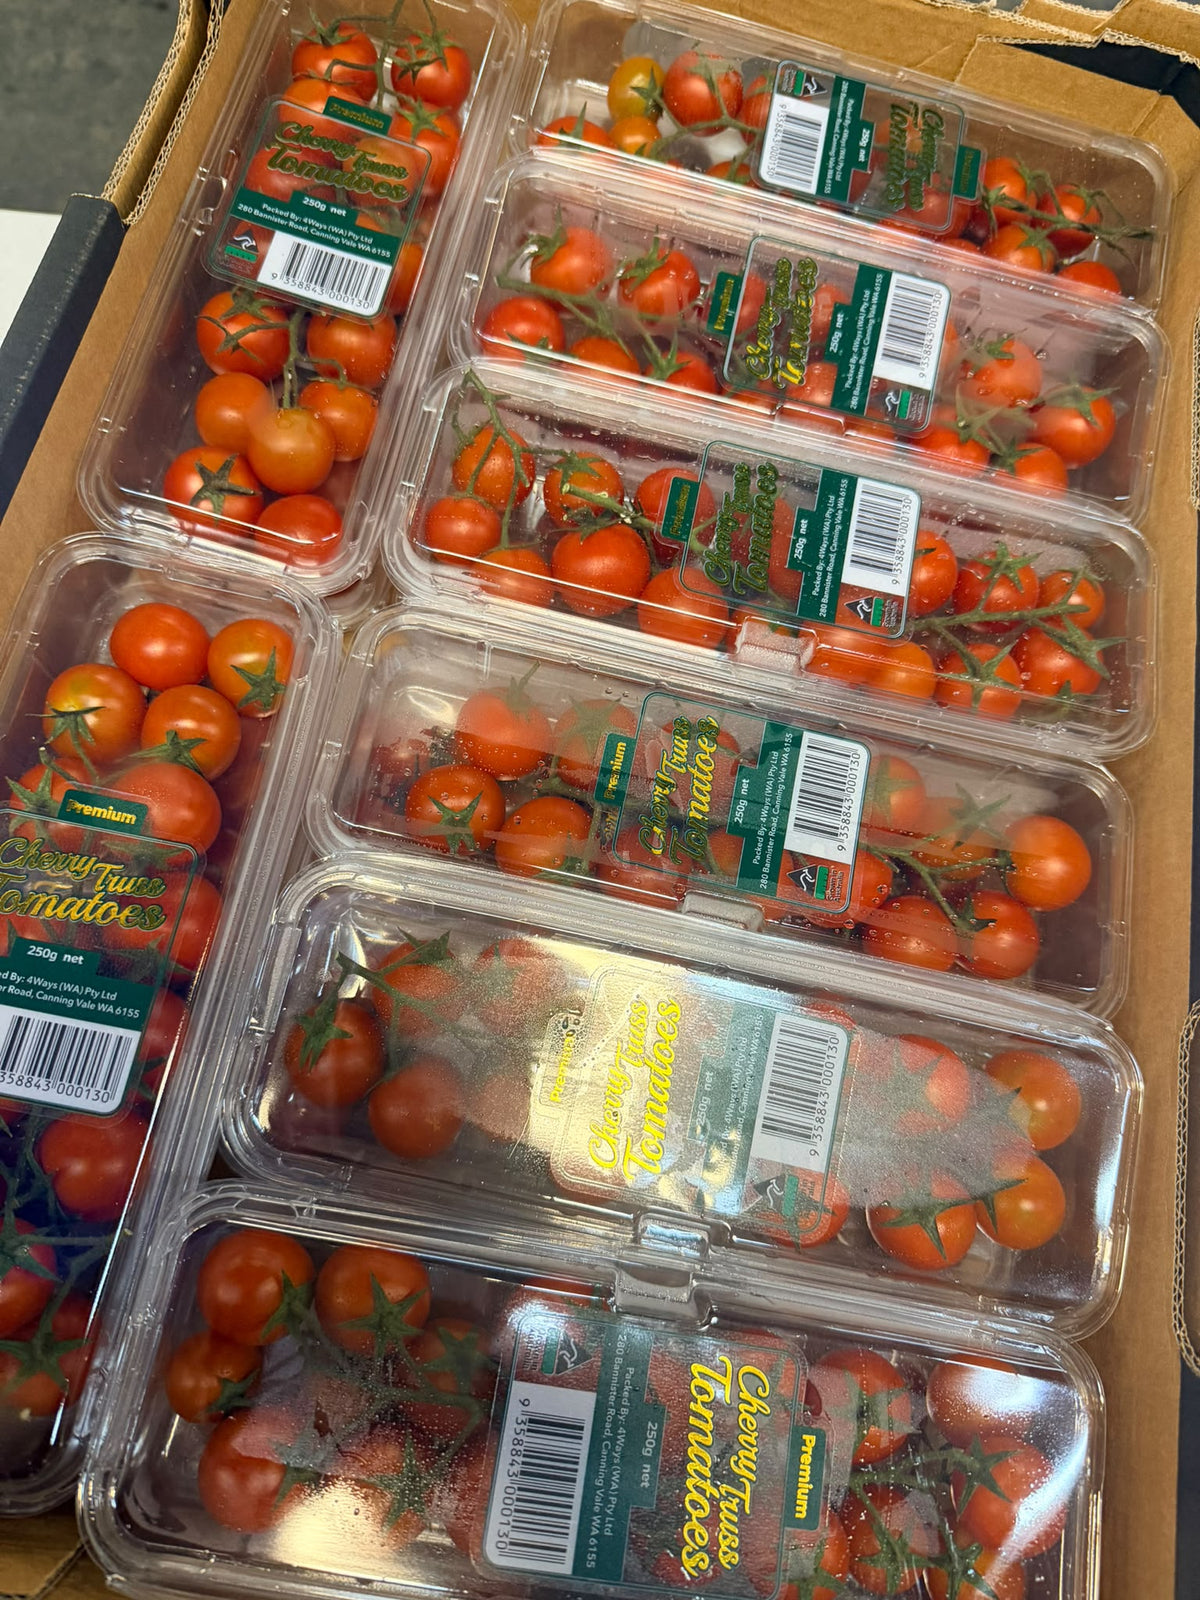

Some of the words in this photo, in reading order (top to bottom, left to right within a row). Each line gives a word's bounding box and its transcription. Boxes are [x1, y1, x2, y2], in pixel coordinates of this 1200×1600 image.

[266, 143, 409, 203] Tomatoes
[353, 152, 409, 181] Truss
[302, 198, 326, 211] 250g
[330, 208, 346, 217] net
[237, 205, 253, 214] 280
[253, 210, 289, 226] Bannister
[288, 222, 308, 233] Road,
[309, 229, 340, 243] Canning
[342, 239, 356, 248] Vale
[356, 244, 371, 253] WA
[371, 248, 391, 259] 6155
[262, 204, 289, 217] Packed
[289, 214, 301, 222] By:
[302, 218, 327, 230] 4Ways
[327, 226, 347, 237] (WA)
[347, 232, 359, 240] Pty
[360, 236, 373, 245] Ltd
[271, 273, 278, 281] 9
[282, 278, 324, 296] 358843
[327, 291, 369, 309] 000130
[874, 275, 882, 292] 6155
[860, 303, 868, 313] Pty
[872, 292, 879, 305] WA
[774, 258, 818, 387] Tomatoes
[857, 314, 866, 331] (WA)
[869, 305, 877, 318] Vale
[830, 333, 840, 354] 250g
[852, 331, 862, 353] 4Ways
[864, 320, 874, 347] Canning
[923, 333, 935, 369] 358843
[929, 293, 942, 330] 000130
[850, 354, 858, 365] By:
[859, 348, 868, 366] Road,
[845, 365, 854, 389] Packed
[852, 365, 864, 397] Bannister
[849, 397, 857, 410] 280
[840, 480, 849, 498] 6155
[826, 508, 834, 519] Pty
[827, 496, 835, 508] Ltd
[838, 497, 846, 510] WA
[734, 463, 778, 593] Tomatoes
[822, 519, 832, 537] (WA)
[835, 511, 844, 524] Vale
[900, 498, 913, 535] 000130
[704, 512, 738, 584] Cherry
[794, 538, 806, 560] 250g
[801, 520, 809, 535] net
[819, 537, 829, 560] 4Ways
[830, 525, 842, 553] Canning
[816, 561, 826, 572] By:
[826, 554, 836, 572] Road,
[895, 539, 907, 576] 358843
[812, 572, 822, 597] Packed
[820, 572, 832, 604] Bannister
[817, 605, 826, 619] 280
[785, 733, 794, 753] 6155
[772, 751, 780, 764] Ltd
[782, 753, 791, 767] WA
[604, 743, 628, 800] Premium
[770, 765, 779, 777] Pty
[780, 768, 789, 782] Vale
[847, 753, 861, 794] 000130
[639, 772, 677, 855] Cherry
[664, 717, 692, 775] Truss
[671, 716, 720, 864] Tomatoes
[766, 777, 777, 798] (WA)
[735, 800, 749, 824] 250g
[742, 779, 751, 796] net
[761, 798, 773, 823] 4Ways
[774, 784, 786, 815] Canning
[66, 800, 136, 825] Premium
[841, 798, 855, 840] 358843
[759, 824, 769, 837] By:
[769, 817, 780, 837] Road,
[753, 837, 765, 866] Packed
[762, 837, 775, 874] Bannister
[838, 845, 848, 853] 9
[0, 839, 96, 882] Cherry
[93, 864, 165, 898] Truss
[759, 875, 768, 891] 280
[27, 946, 58, 962] 250g
[62, 954, 84, 965] net
[10, 973, 25, 985] By:
[26, 976, 58, 990] 4Ways
[58, 982, 84, 996] (WA)
[83, 988, 99, 999] Pty
[100, 991, 117, 1002] Ltd
[8, 985, 33, 999] Road,
[35, 991, 74, 1007] Canning
[77, 999, 95, 1011] Vale
[95, 1004, 114, 1015] WA
[113, 1007, 140, 1020] 6155
[0, 1071, 50, 1090] 358843
[54, 1082, 109, 1103] 000130
[616, 1335, 627, 1355] 280
[608, 1357, 623, 1407] Bannister
[621, 1367, 634, 1406] Packed
[518, 1398, 530, 1408] 9
[603, 1408, 616, 1438] Road,
[616, 1408, 628, 1425] By:
[730, 1366, 770, 1482] Cherry
[507, 1417, 526, 1478] 358843
[613, 1427, 626, 1464] 4Ways
[643, 1422, 658, 1457] 250g
[595, 1441, 611, 1487] Canning
[640, 1464, 650, 1488] net
[682, 1356, 732, 1577] Tomatoes
[796, 1434, 816, 1519] Premium
[608, 1465, 622, 1495] (WA)
[593, 1490, 604, 1513] Vale
[606, 1497, 617, 1515] Pty
[496, 1486, 517, 1551] 000130
[590, 1514, 601, 1536] WA
[604, 1517, 615, 1536] Ltd
[718, 1479, 749, 1570] Truss
[586, 1538, 598, 1569] 6155
